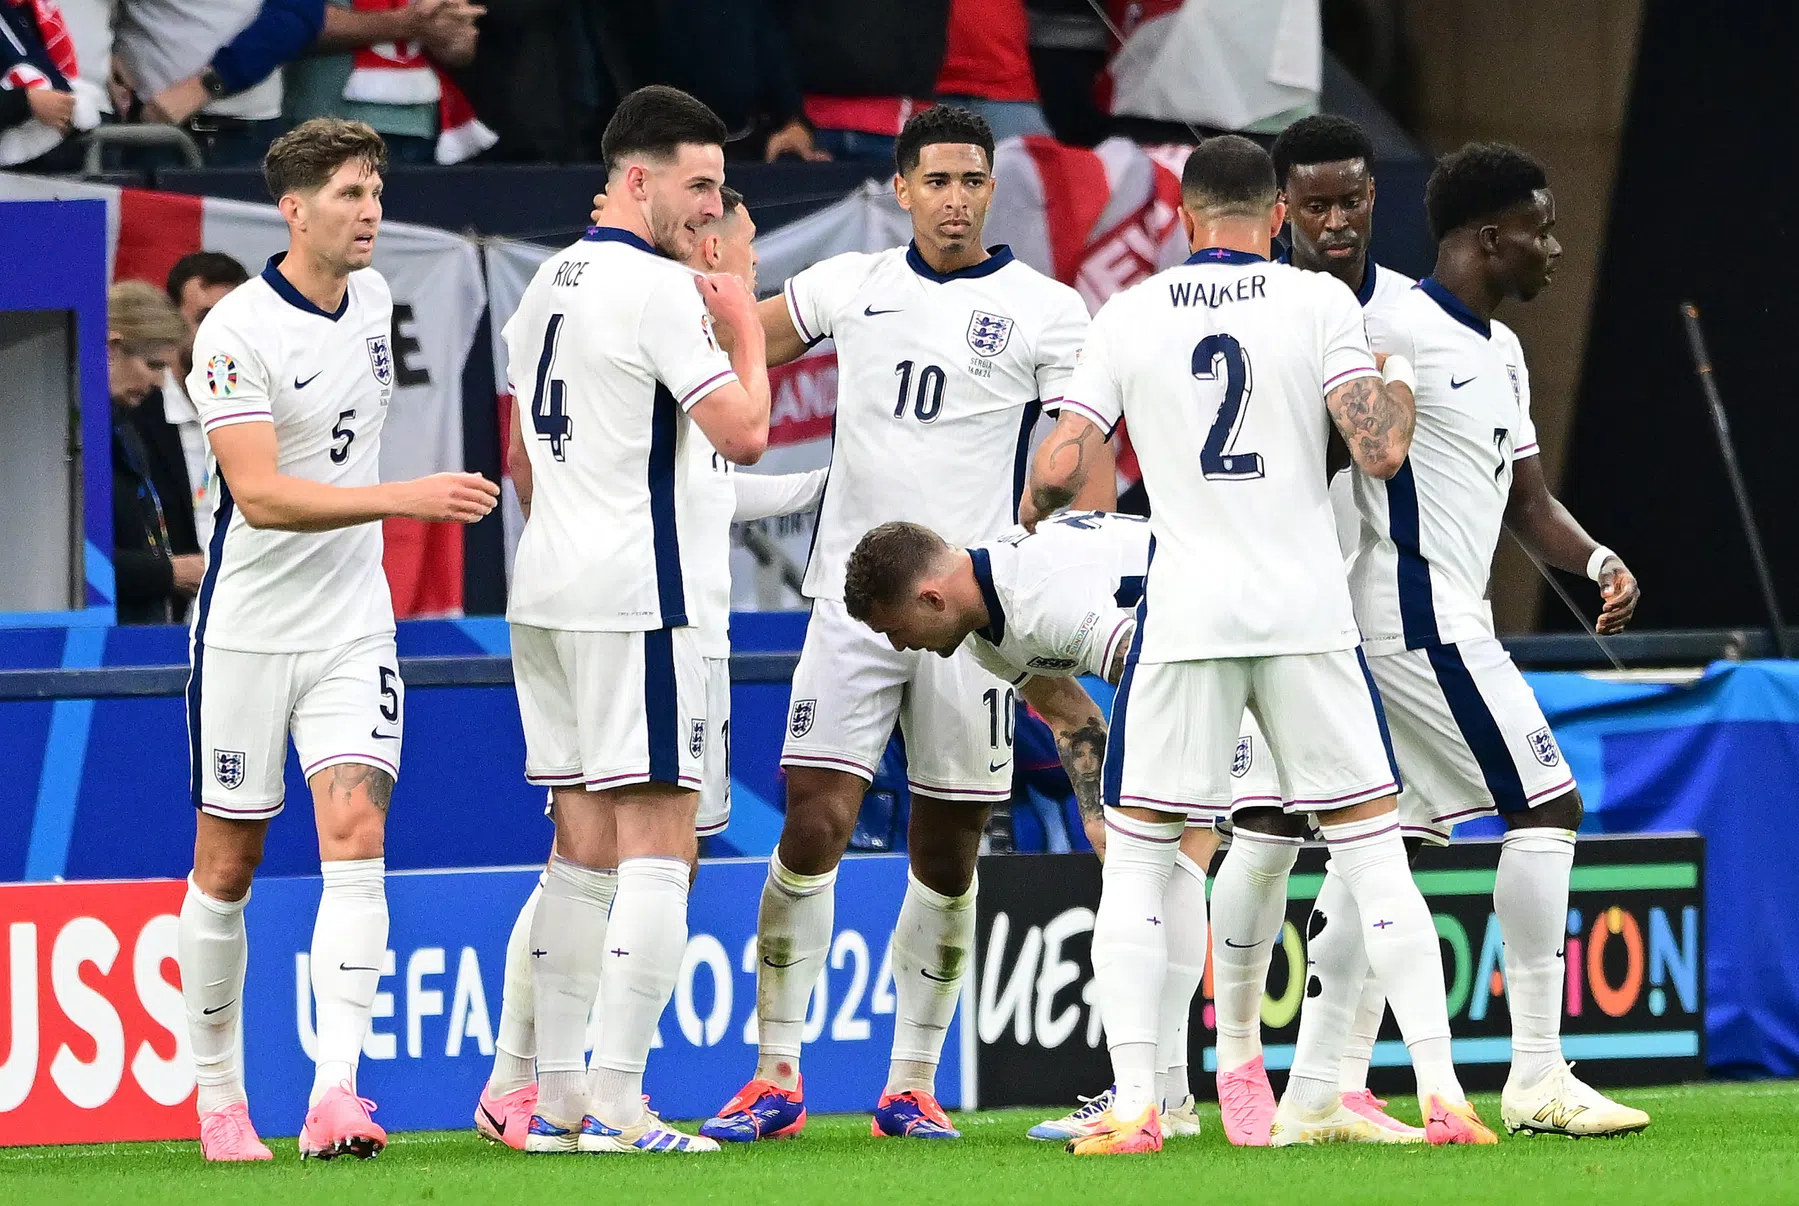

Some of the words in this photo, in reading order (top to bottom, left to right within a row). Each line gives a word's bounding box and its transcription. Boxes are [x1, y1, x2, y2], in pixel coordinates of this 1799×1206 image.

[552, 261, 589, 288] RICE
[1169, 275, 1266, 308] WALKER
[531, 313, 573, 462] 4
[894, 360, 947, 424] 10
[969, 357, 993, 370] SERBIA
[1191, 333, 1265, 481] 2
[330, 409, 357, 466] 5
[1493, 428, 1509, 485] 7
[379, 666, 399, 725] 5
[983, 688, 1014, 749] 10
